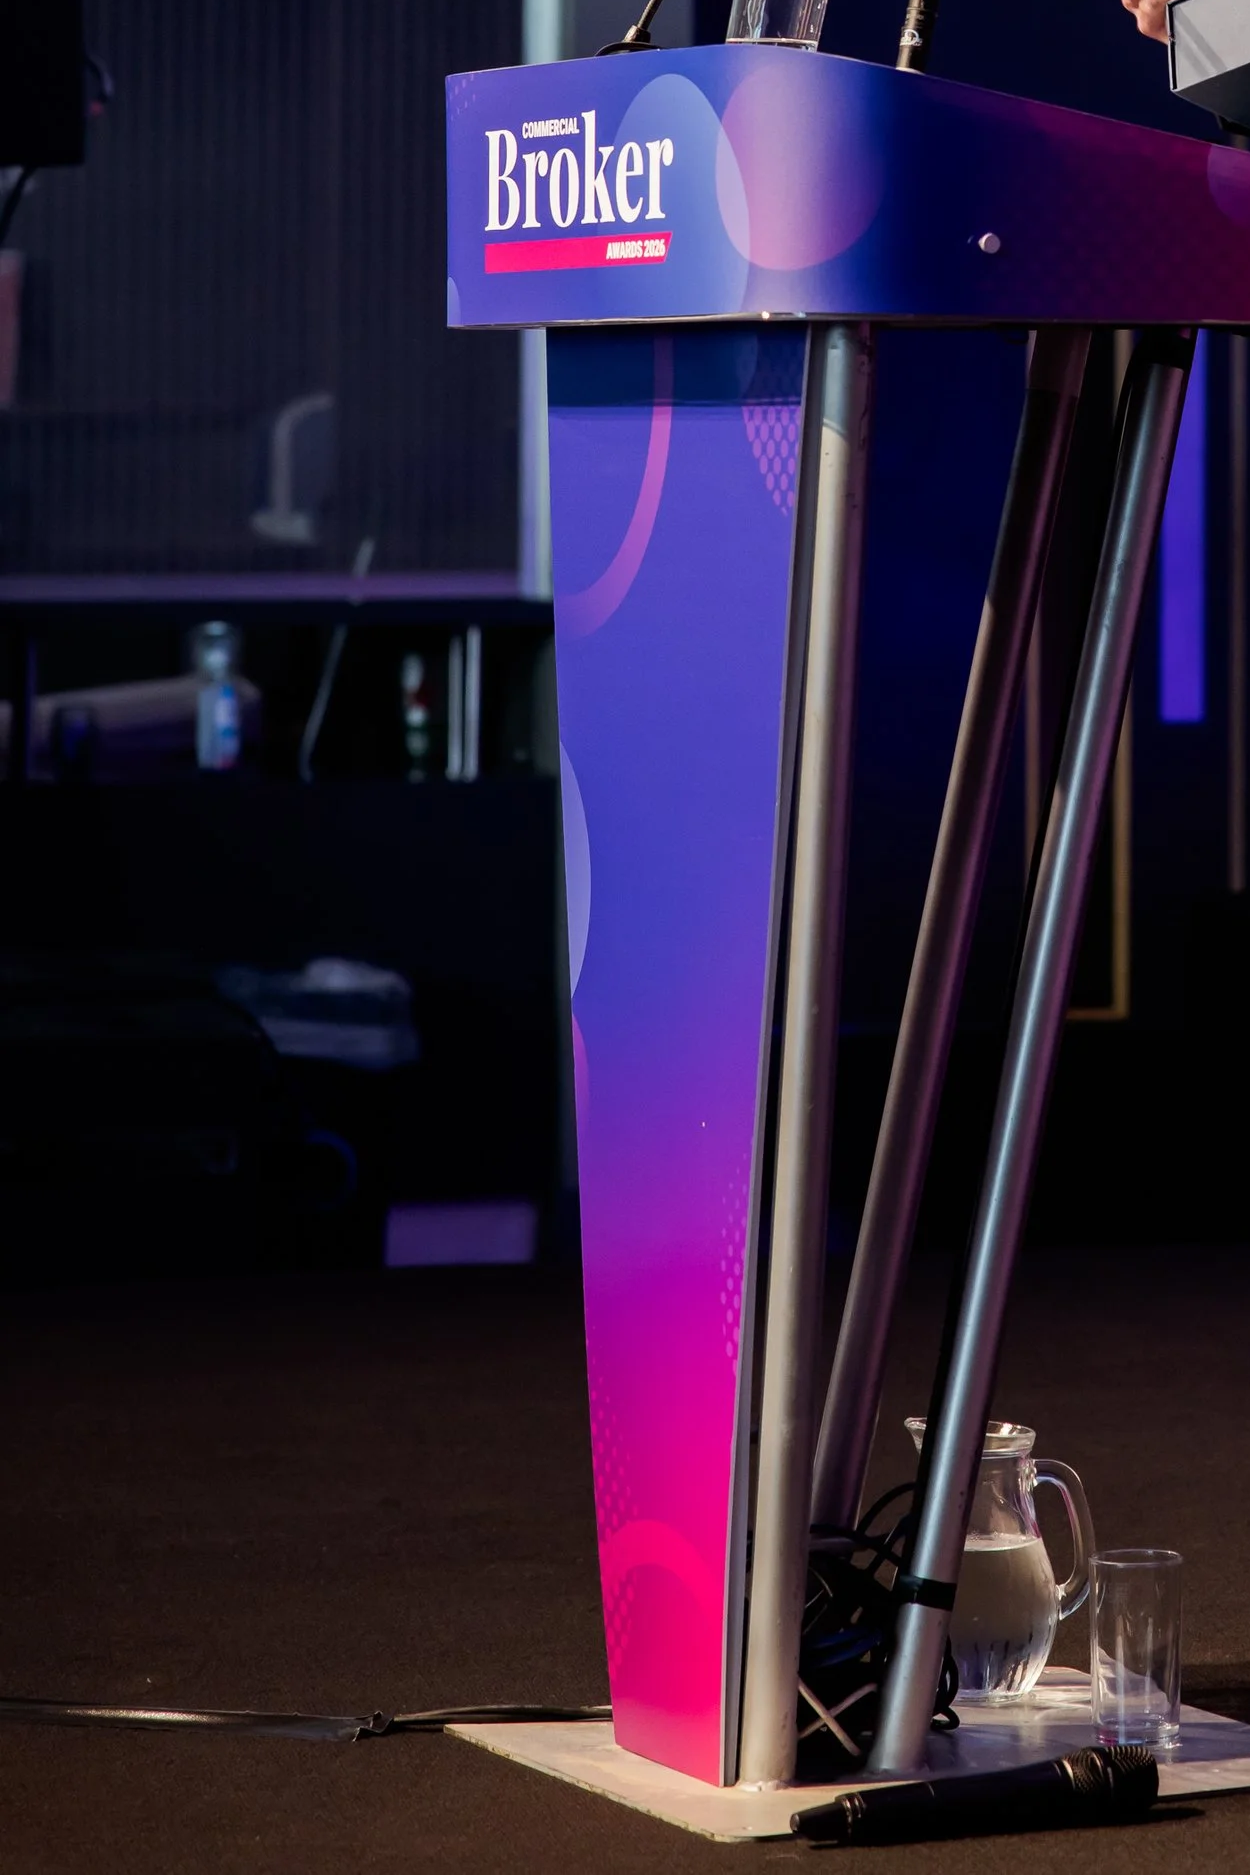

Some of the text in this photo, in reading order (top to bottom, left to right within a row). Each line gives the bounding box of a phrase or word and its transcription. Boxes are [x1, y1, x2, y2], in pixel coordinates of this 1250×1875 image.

[522, 117, 580, 139] COMMERCIAL
[484, 110, 674, 231] Broker
[605, 238, 666, 260] AWARDS 2026
